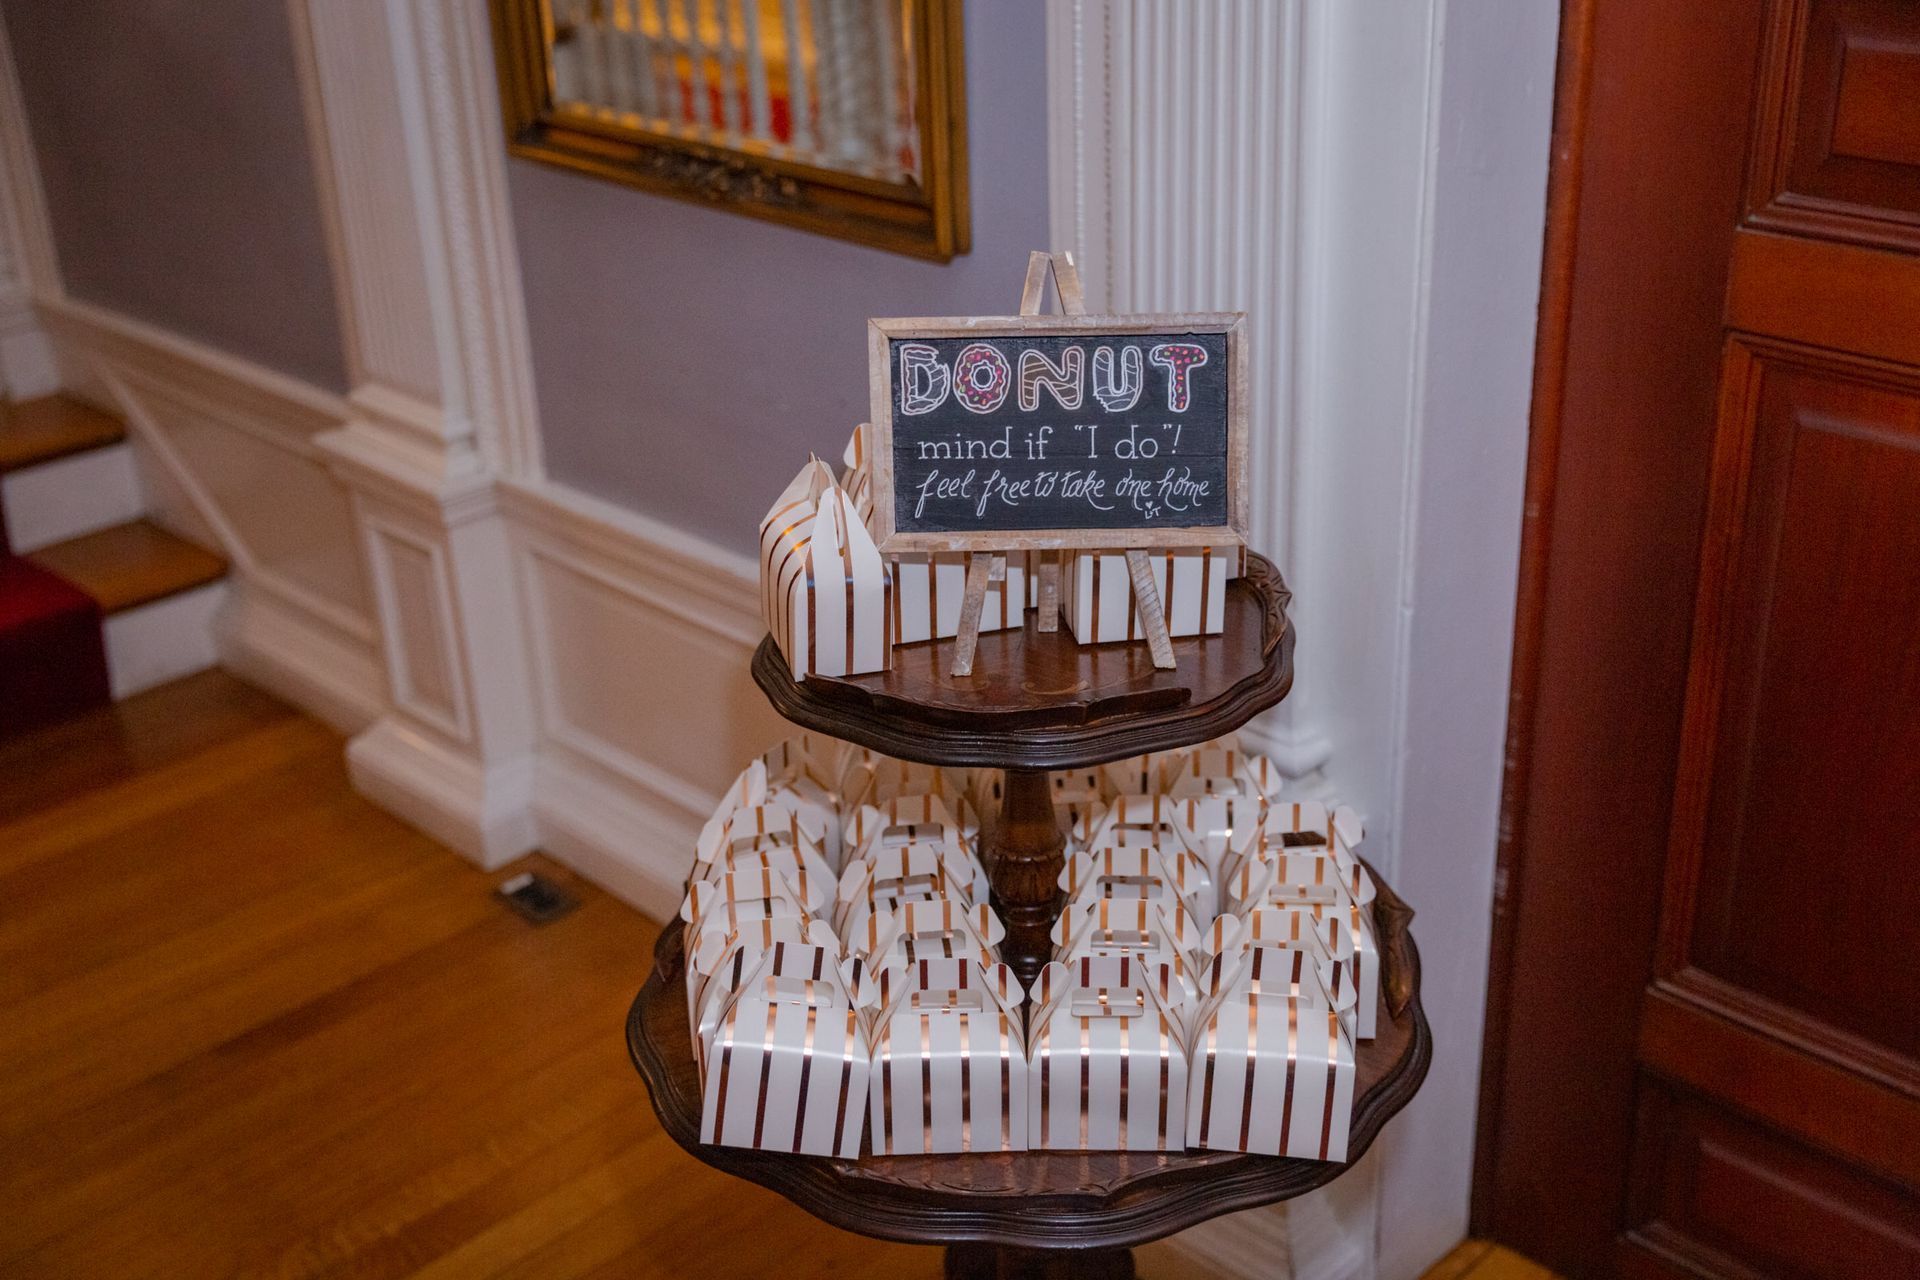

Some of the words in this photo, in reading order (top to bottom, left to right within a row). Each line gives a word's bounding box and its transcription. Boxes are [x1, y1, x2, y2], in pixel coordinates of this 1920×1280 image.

[900, 343, 1208, 416] DONUT
[917, 426, 1013, 460] mind
[1024, 426, 1053, 460] if
[915, 469, 976, 518] feel
[976, 469, 1031, 517] free
[1034, 471, 1059, 498] to
[1060, 470, 1115, 510] take
[1115, 468, 1152, 511] one
[1156, 466, 1210, 511] home
